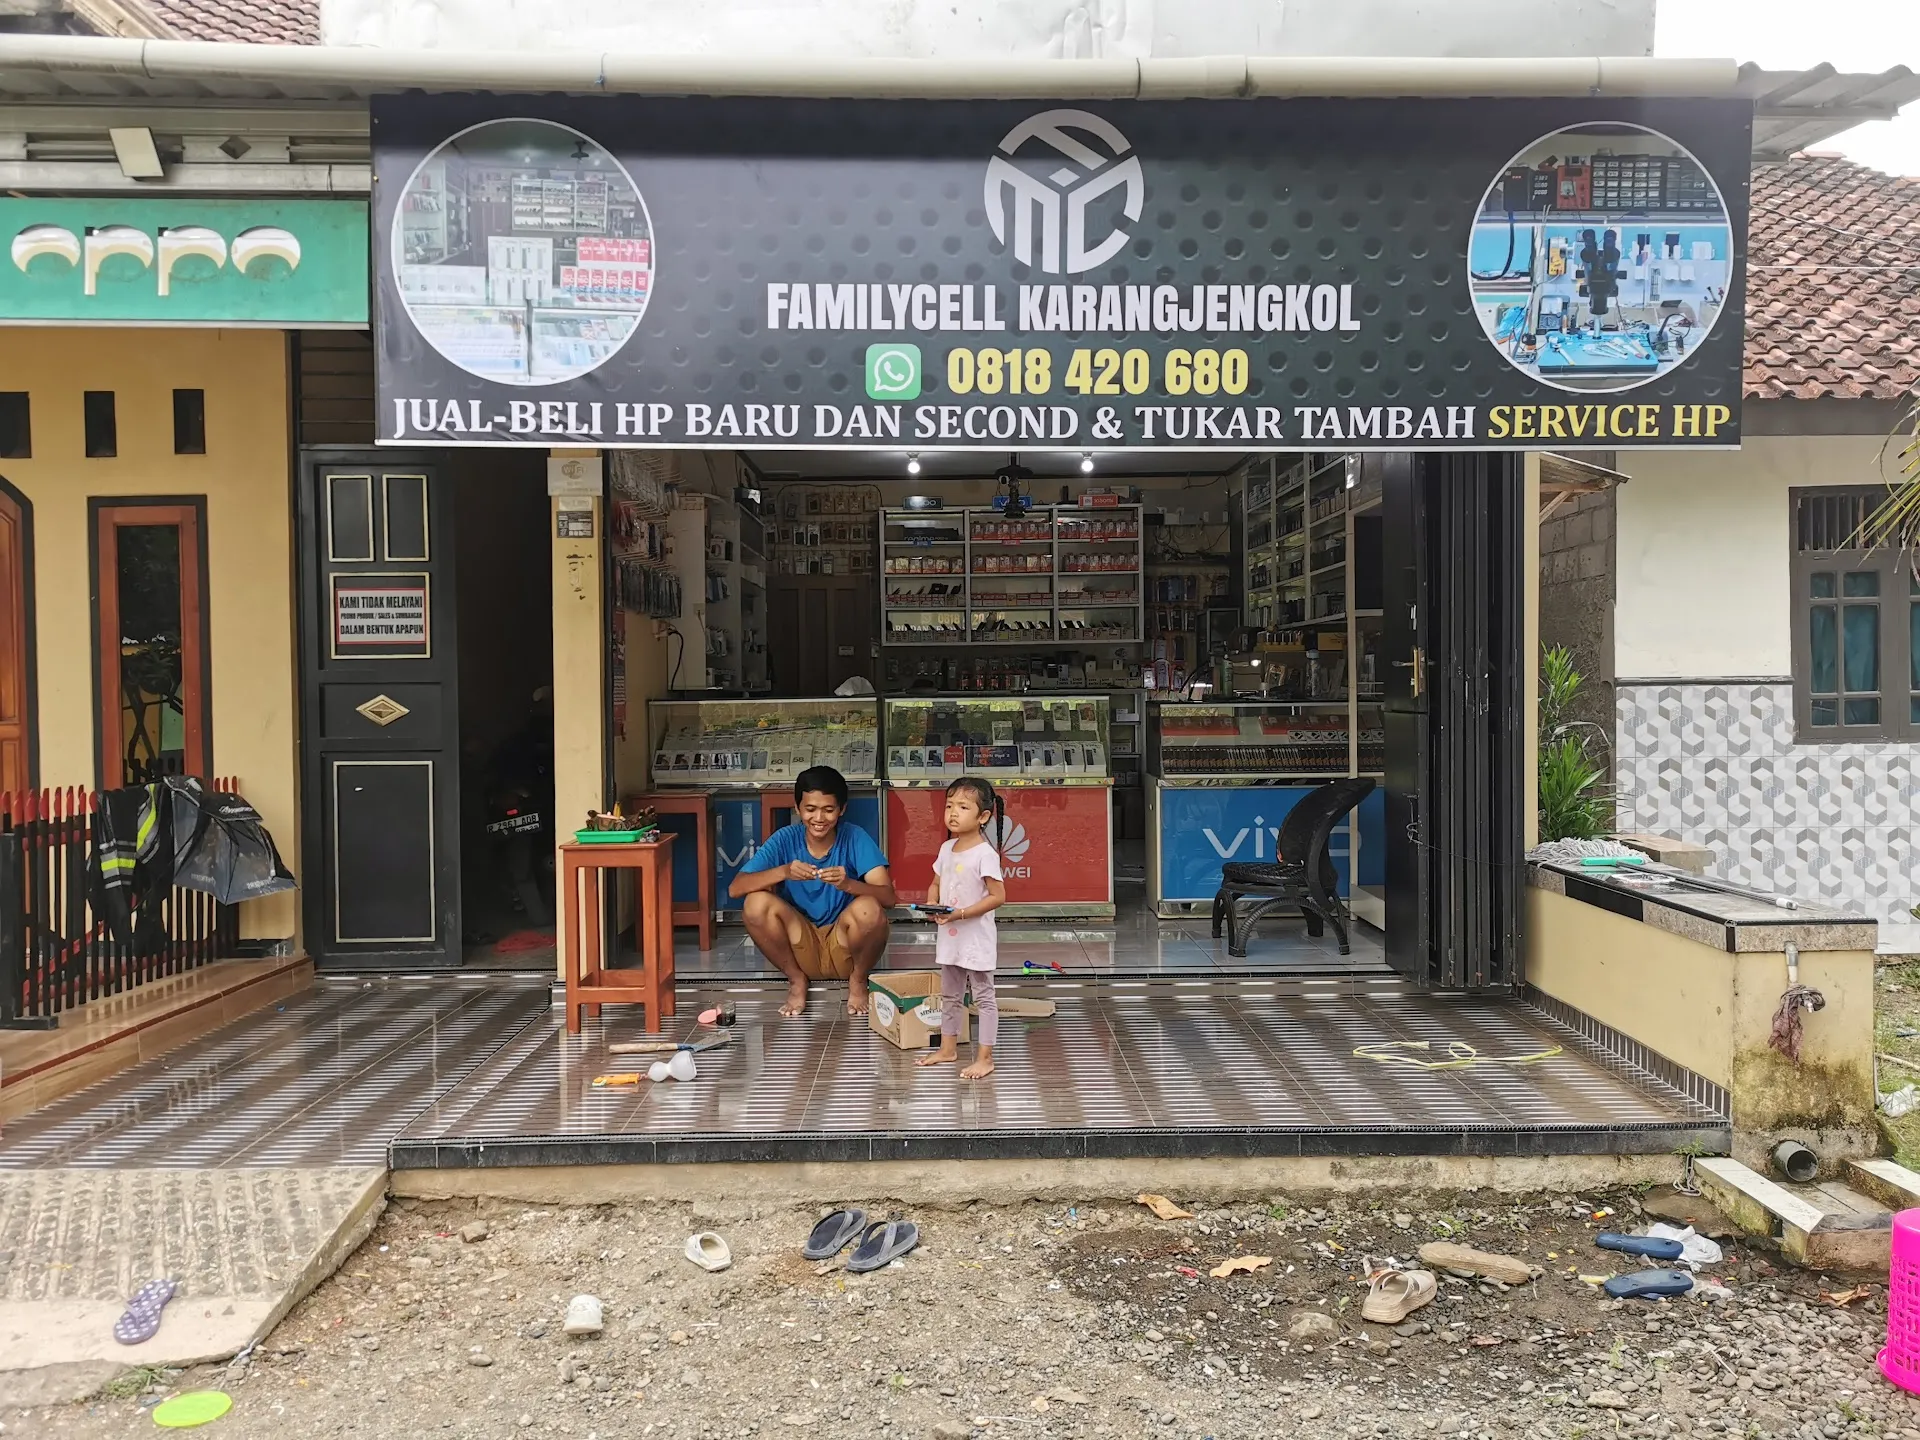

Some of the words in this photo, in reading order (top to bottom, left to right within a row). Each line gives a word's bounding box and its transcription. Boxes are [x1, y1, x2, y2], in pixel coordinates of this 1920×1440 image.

[767, 283, 1006, 331] FAMILYCELL
[1019, 284, 1361, 331] KARANGJENGKOL
[947, 347, 1051, 395] 0818
[1064, 348, 1150, 395] 420
[1164, 348, 1249, 395] 680
[393, 398, 603, 439] JUAL-BELI
[615, 402, 674, 436] HP
[684, 403, 800, 438] BARU
[814, 405, 902, 438] DAN
[914, 405, 1079, 439] SECOND
[1091, 406, 1124, 439] &
[1134, 406, 1283, 439] TUKAR
[1294, 406, 1476, 439] TAMBAH
[1487, 404, 1660, 438] SERVICE
[1671, 404, 1731, 438] HP
[339, 597, 360, 608] KAMI
[361, 597, 384, 608] TIDAK
[386, 596, 423, 608] MELAYANI
[341, 625, 364, 634] DALAM
[366, 625, 394, 634] BENTUK
[396, 624, 424, 634] APAPUN
